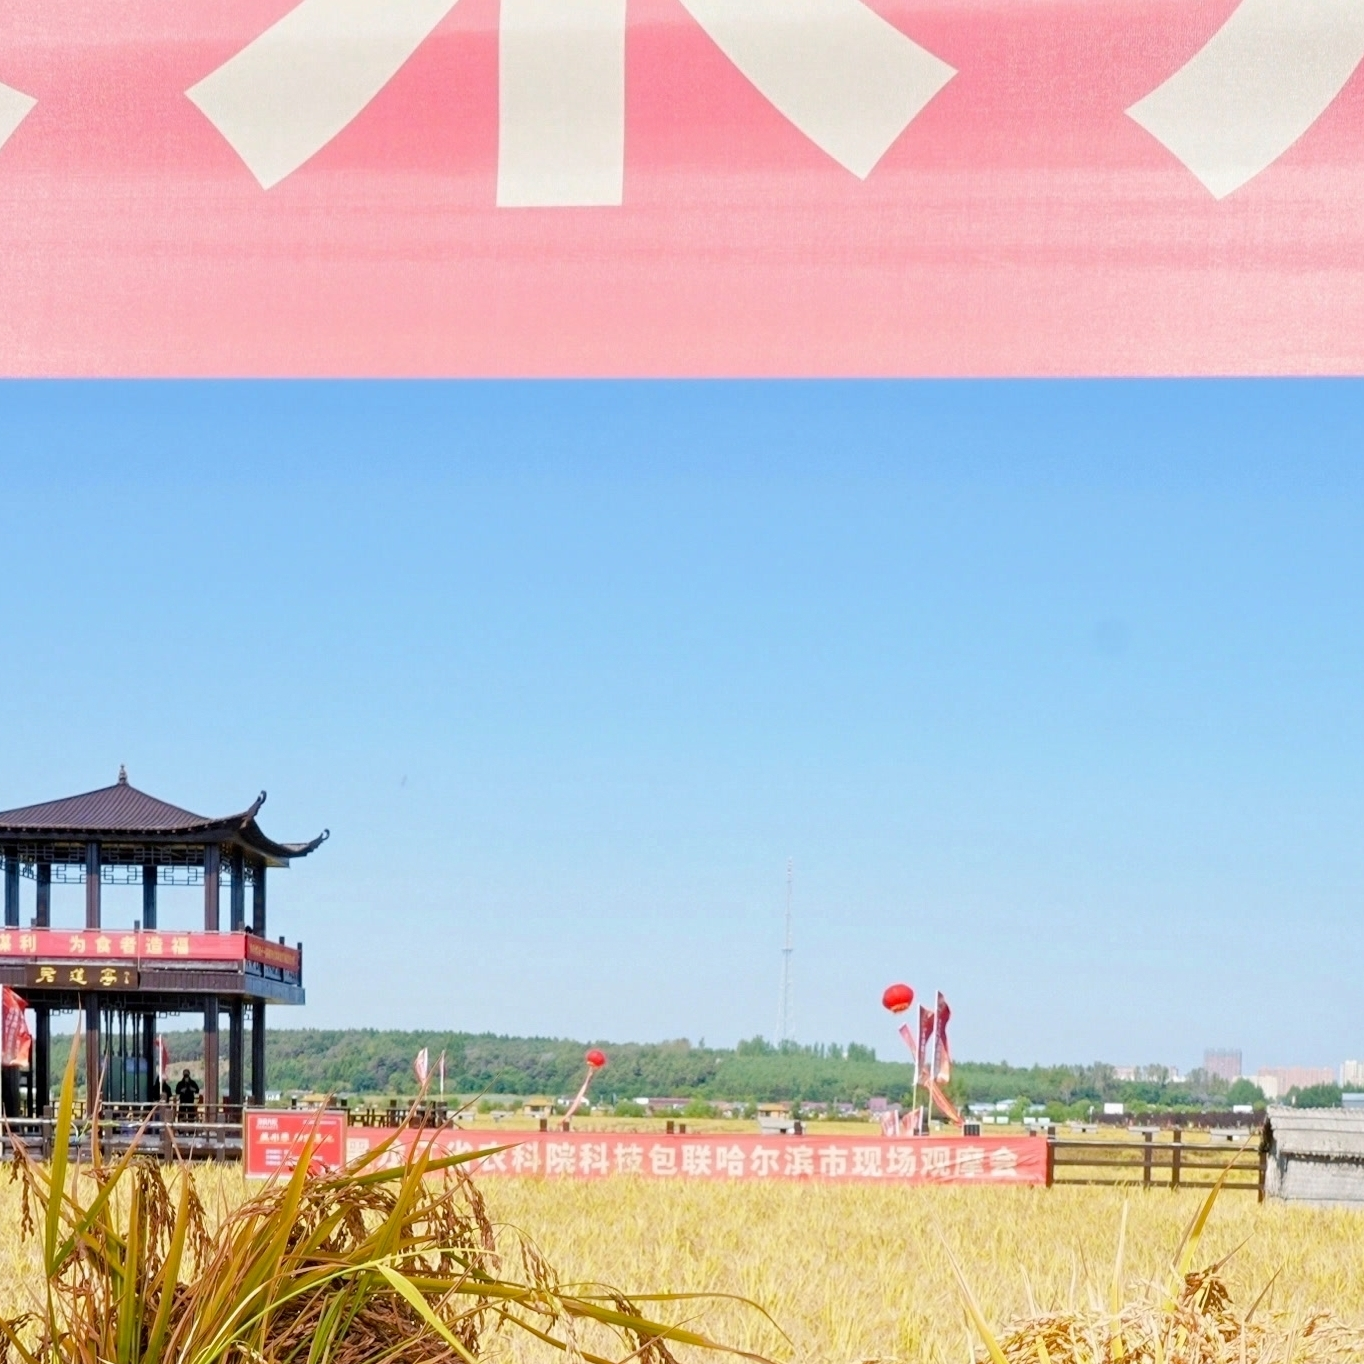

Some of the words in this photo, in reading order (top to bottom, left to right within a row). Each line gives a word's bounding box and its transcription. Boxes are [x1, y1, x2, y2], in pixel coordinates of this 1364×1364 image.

[69, 933, 191, 956] 为食者造福
